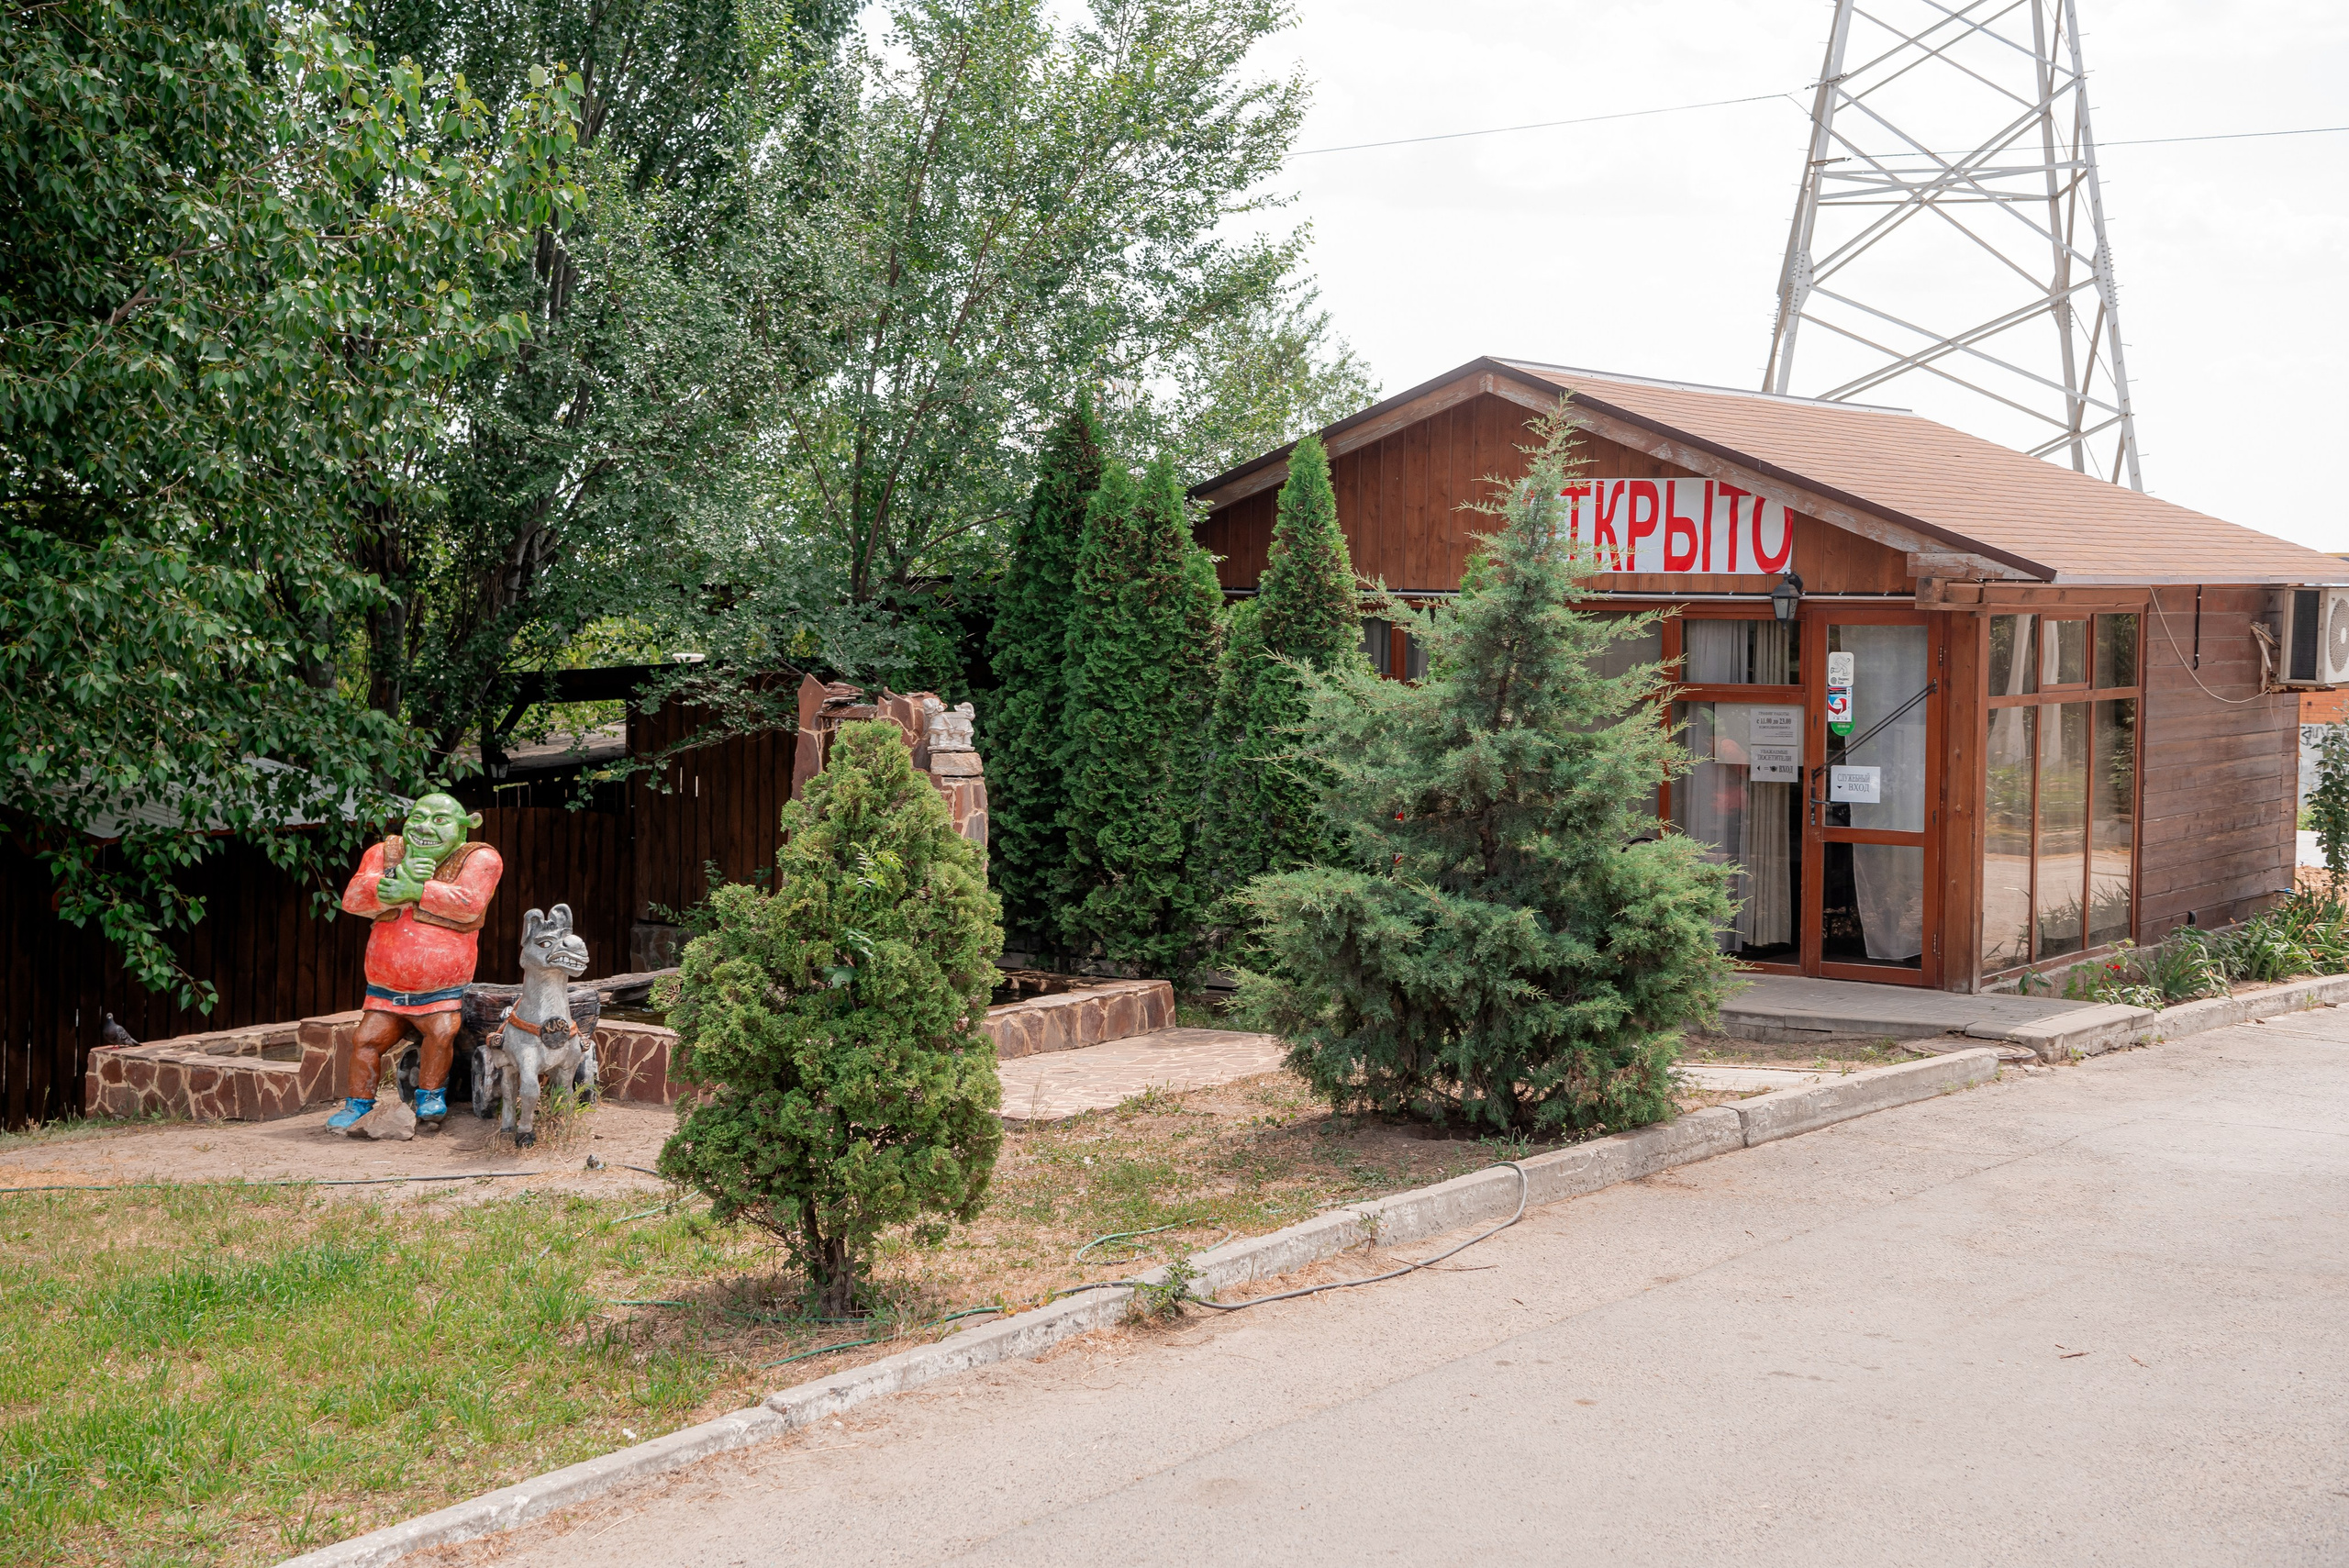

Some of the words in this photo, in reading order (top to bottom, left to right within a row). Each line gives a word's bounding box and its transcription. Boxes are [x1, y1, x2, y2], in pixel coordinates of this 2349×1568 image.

[1520, 479, 1793, 573] ТКРЫТО
[1778, 764, 1793, 773] ВХОД
[1837, 773, 1870, 783] СЛУЖЕБНЫЙ
[1848, 783, 1869, 793] ВХОД
[545, 1019, 569, 1034] КАФЕ
